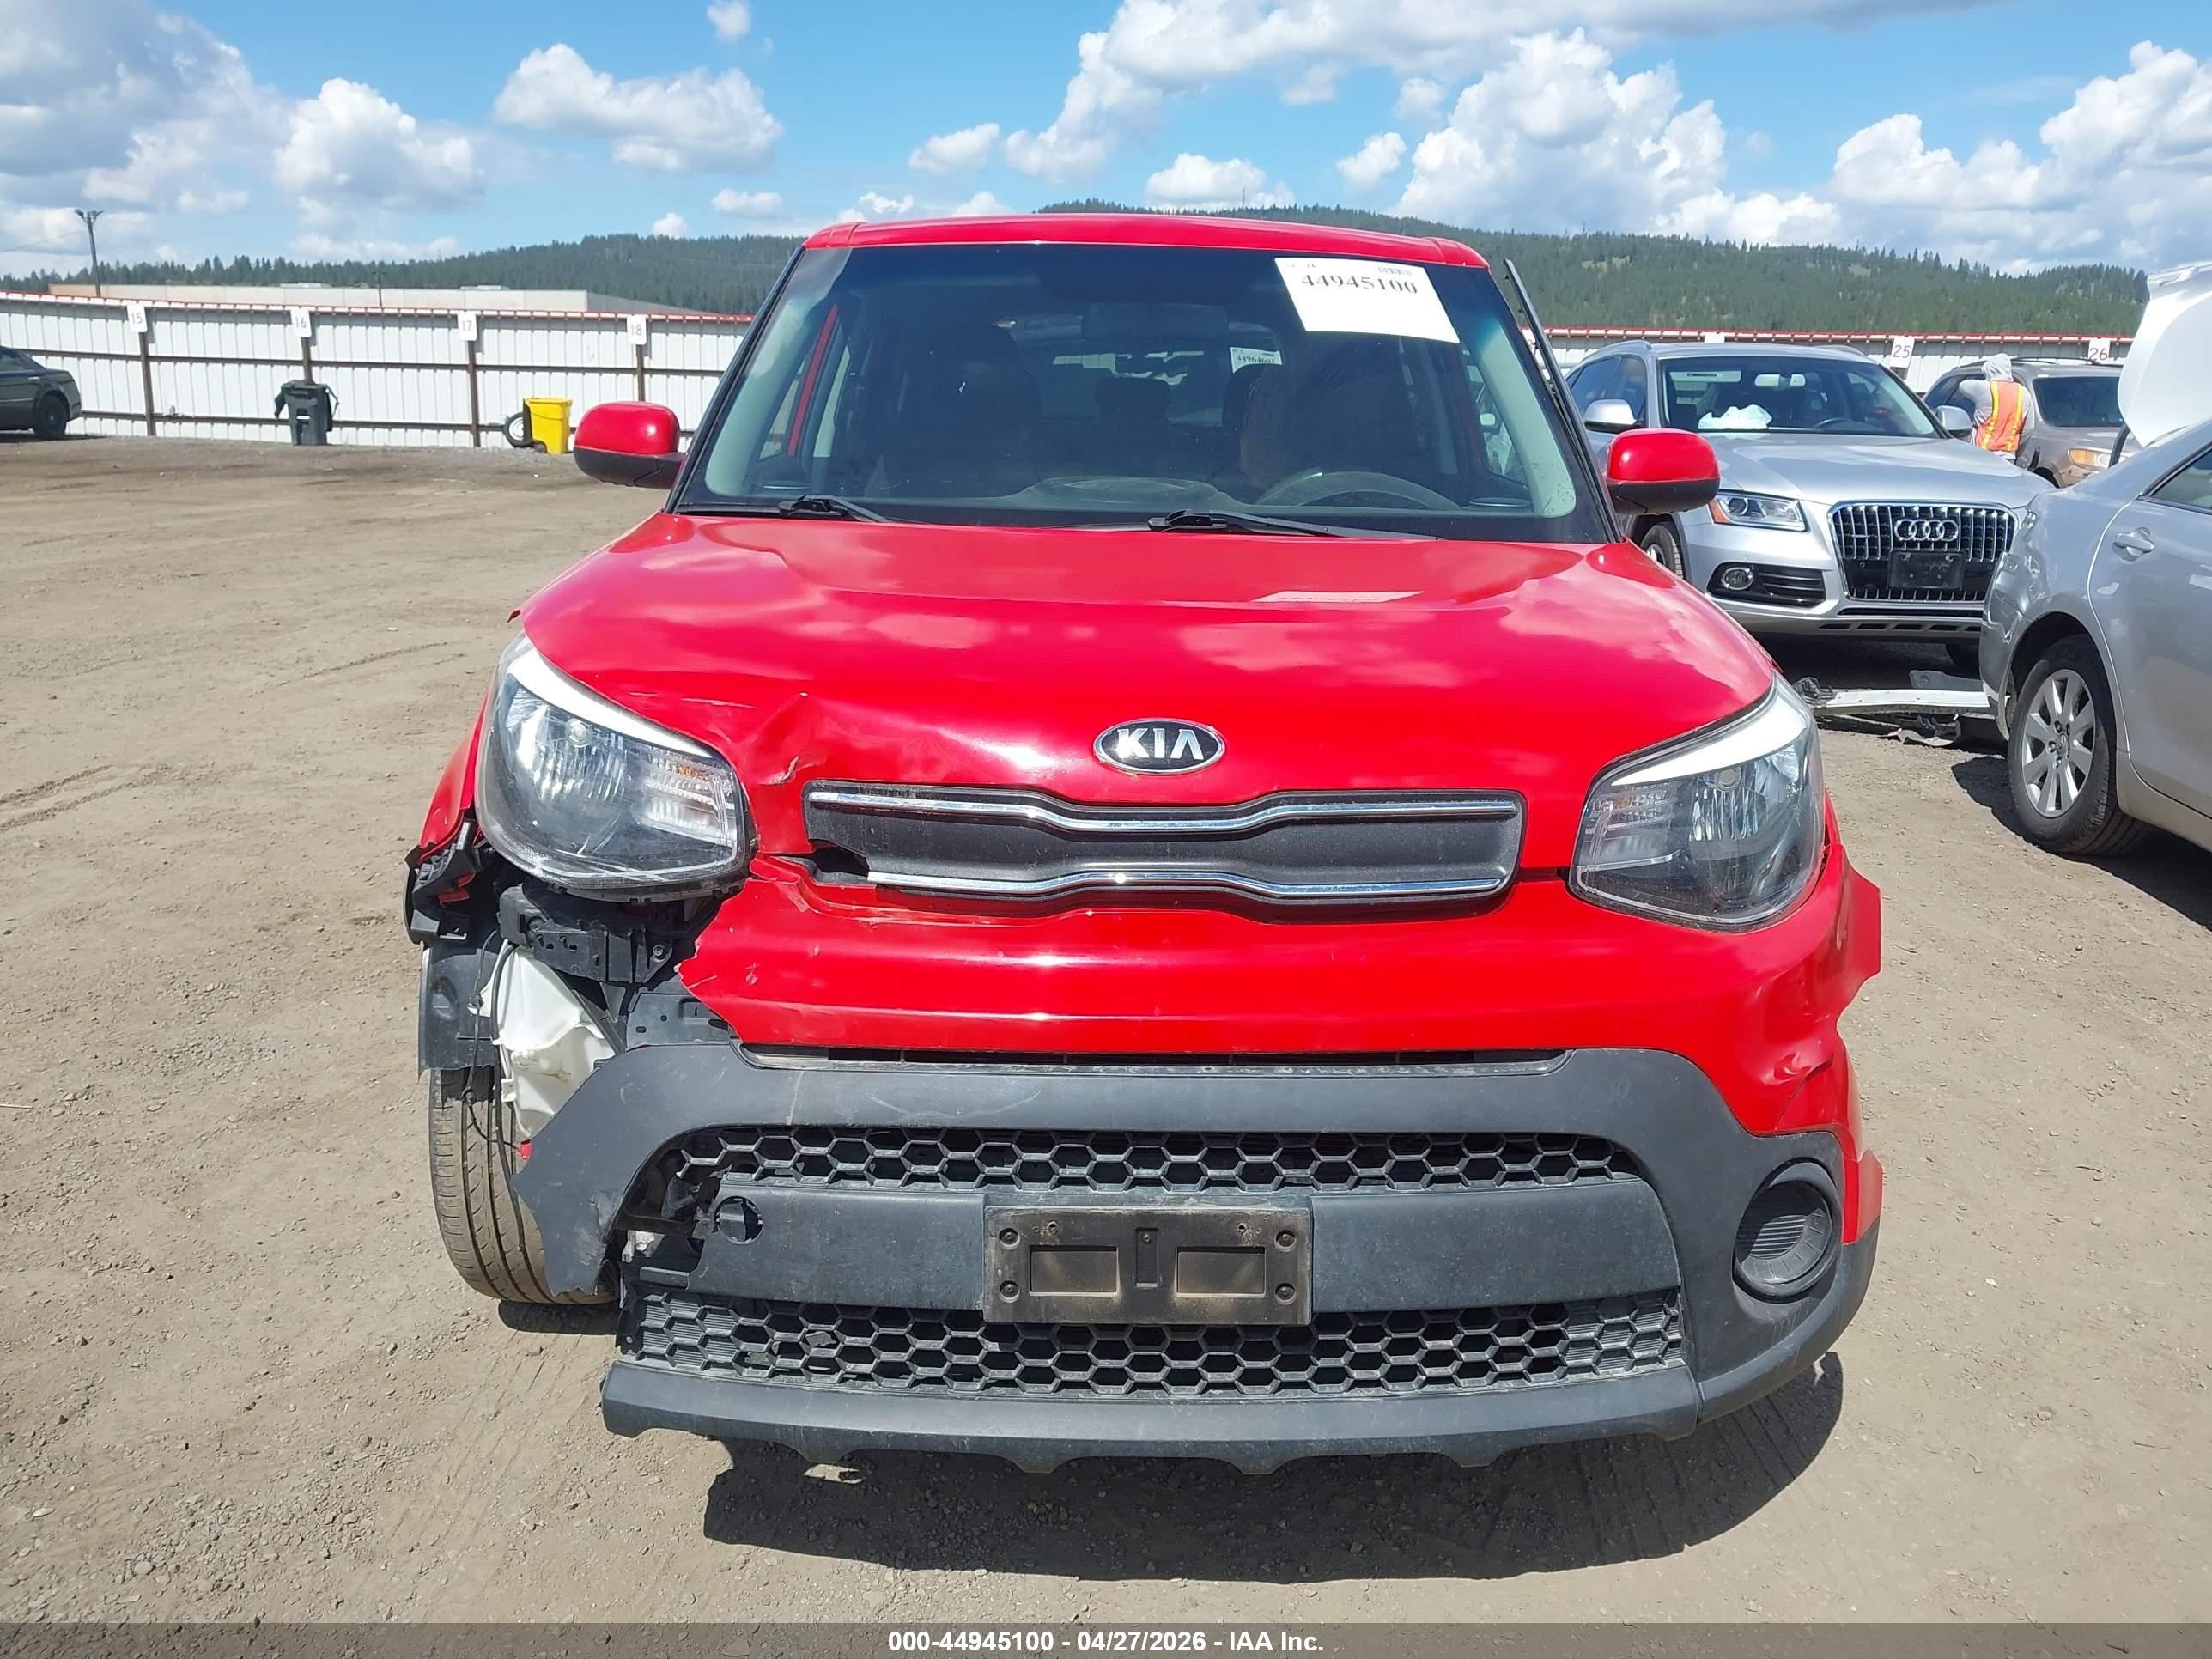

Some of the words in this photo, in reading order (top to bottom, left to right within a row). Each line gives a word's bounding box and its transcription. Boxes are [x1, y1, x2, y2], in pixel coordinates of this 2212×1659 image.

[1301, 273, 1419, 295] 44945100
[131, 312, 143, 325] 15
[295, 316, 307, 329] 16
[461, 319, 473, 332] 17
[630, 323, 643, 336] 18
[1893, 344, 1911, 358] 25
[2089, 348, 2109, 361] 26
[1116, 728, 1204, 760] KIA
